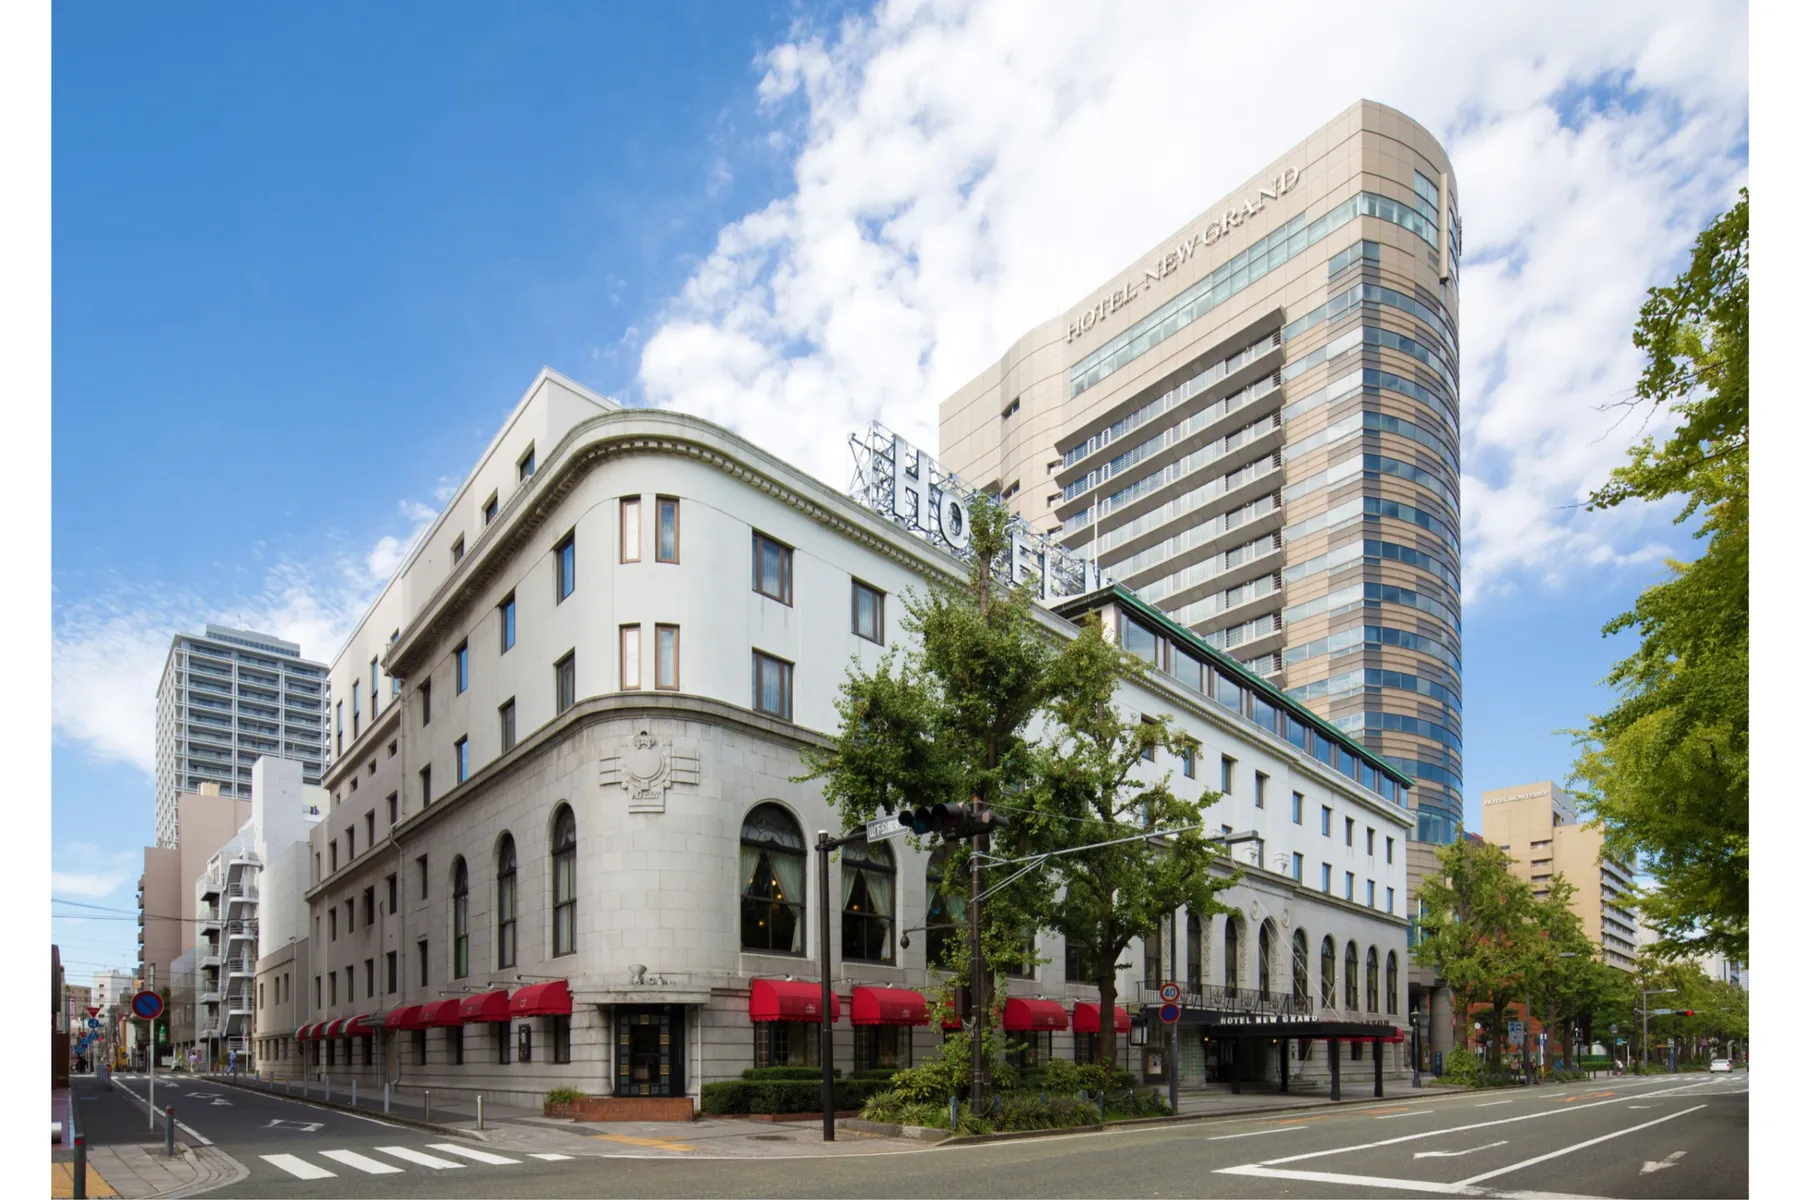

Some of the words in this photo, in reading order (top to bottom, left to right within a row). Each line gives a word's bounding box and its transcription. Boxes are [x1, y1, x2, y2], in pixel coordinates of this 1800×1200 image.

[1066, 283, 1138, 344] HOTEL
[1143, 234, 1199, 292] NEW
[1202, 165, 1301, 248] GRAND
[893, 433, 1053, 602] HOEL
[1164, 988, 1176, 998] 40
[1220, 1016, 1252, 1025] HOTEL
[1255, 1015, 1278, 1024] NEW
[1282, 1014, 1318, 1024] GRAND
